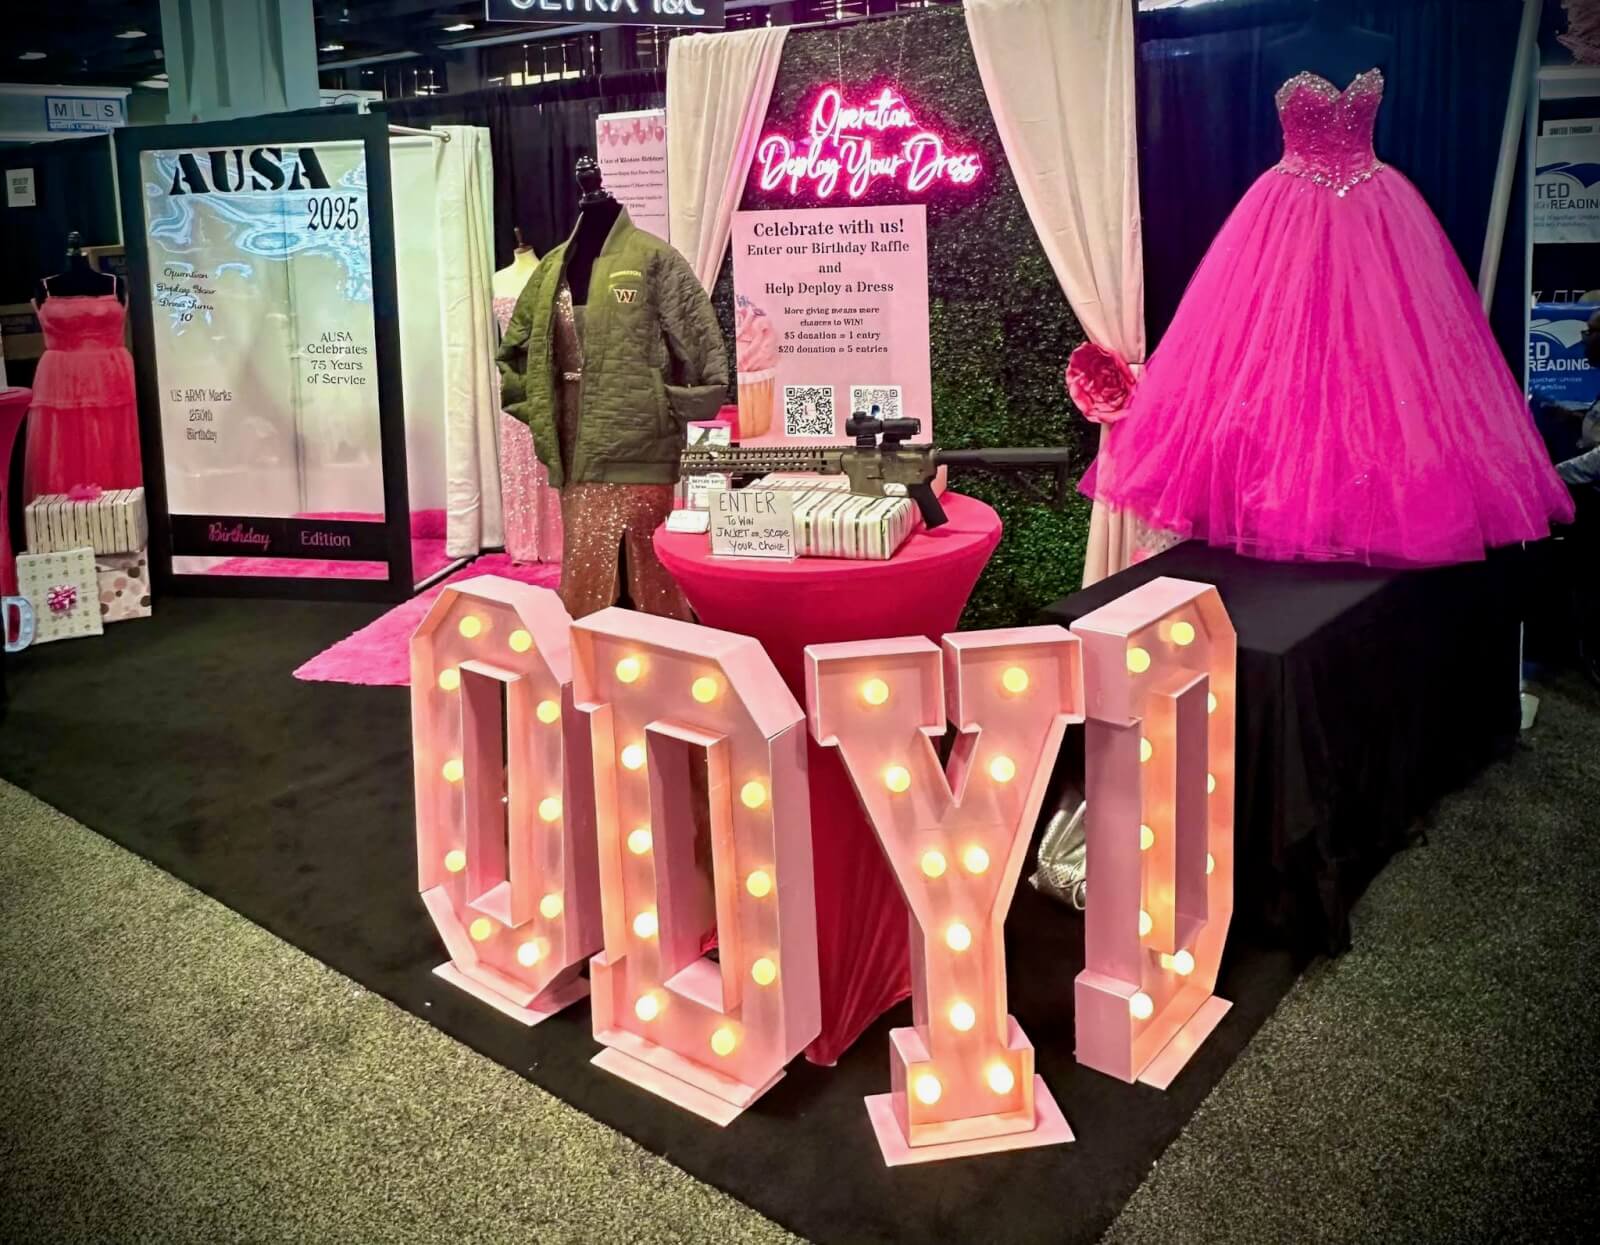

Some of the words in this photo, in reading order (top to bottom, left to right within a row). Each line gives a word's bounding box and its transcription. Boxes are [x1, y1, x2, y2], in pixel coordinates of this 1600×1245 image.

[810, 88, 916, 146] Operation
[169, 147, 331, 196] AUSA
[758, 135, 842, 197] Deploy
[840, 139, 906, 198] Your
[903, 132, 980, 192] Dress
[1550, 199, 1600, 210] READIN
[307, 196, 359, 231] 2025
[753, 221, 834, 237] Celebrate
[839, 218, 874, 234] with
[880, 218, 905, 233] us!
[747, 244, 783, 256] Enter
[786, 245, 808, 255] our
[811, 241, 867, 255] Birthday
[871, 240, 910, 253] Raffle
[818, 261, 842, 274] and
[765, 283, 794, 296] Help
[798, 281, 842, 295] Deploy
[845, 284, 853, 293] a
[857, 281, 894, 293] Dress
[180, 312, 194, 322] 10
[784, 306, 804, 315] More
[806, 306, 830, 316] giving
[800, 319, 832, 327] chances
[843, 318, 864, 326] WIN!
[321, 331, 353, 343] AUSA
[784, 331, 795, 340] $5
[797, 331, 837, 340] donation
[849, 331, 853, 340] 1
[856, 331, 881, 341] entry
[307, 343, 368, 355] Celebrates
[778, 345, 795, 354] $20
[796, 345, 836, 354] donation
[847, 345, 853, 353] 5
[855, 345, 889, 353] entries
[311, 359, 327, 370] 75
[330, 359, 364, 370] Years
[1529, 359, 1591, 372] READING
[307, 373, 320, 385] of
[322, 373, 367, 385] Service
[169, 388, 183, 402] US
[184, 388, 207, 402] ARMY
[208, 388, 233, 402] Marks
[186, 427, 218, 444] Birthday
[719, 491, 777, 515] ENTER
[208, 522, 272, 552] Birthday
[301, 530, 351, 547] Edition
